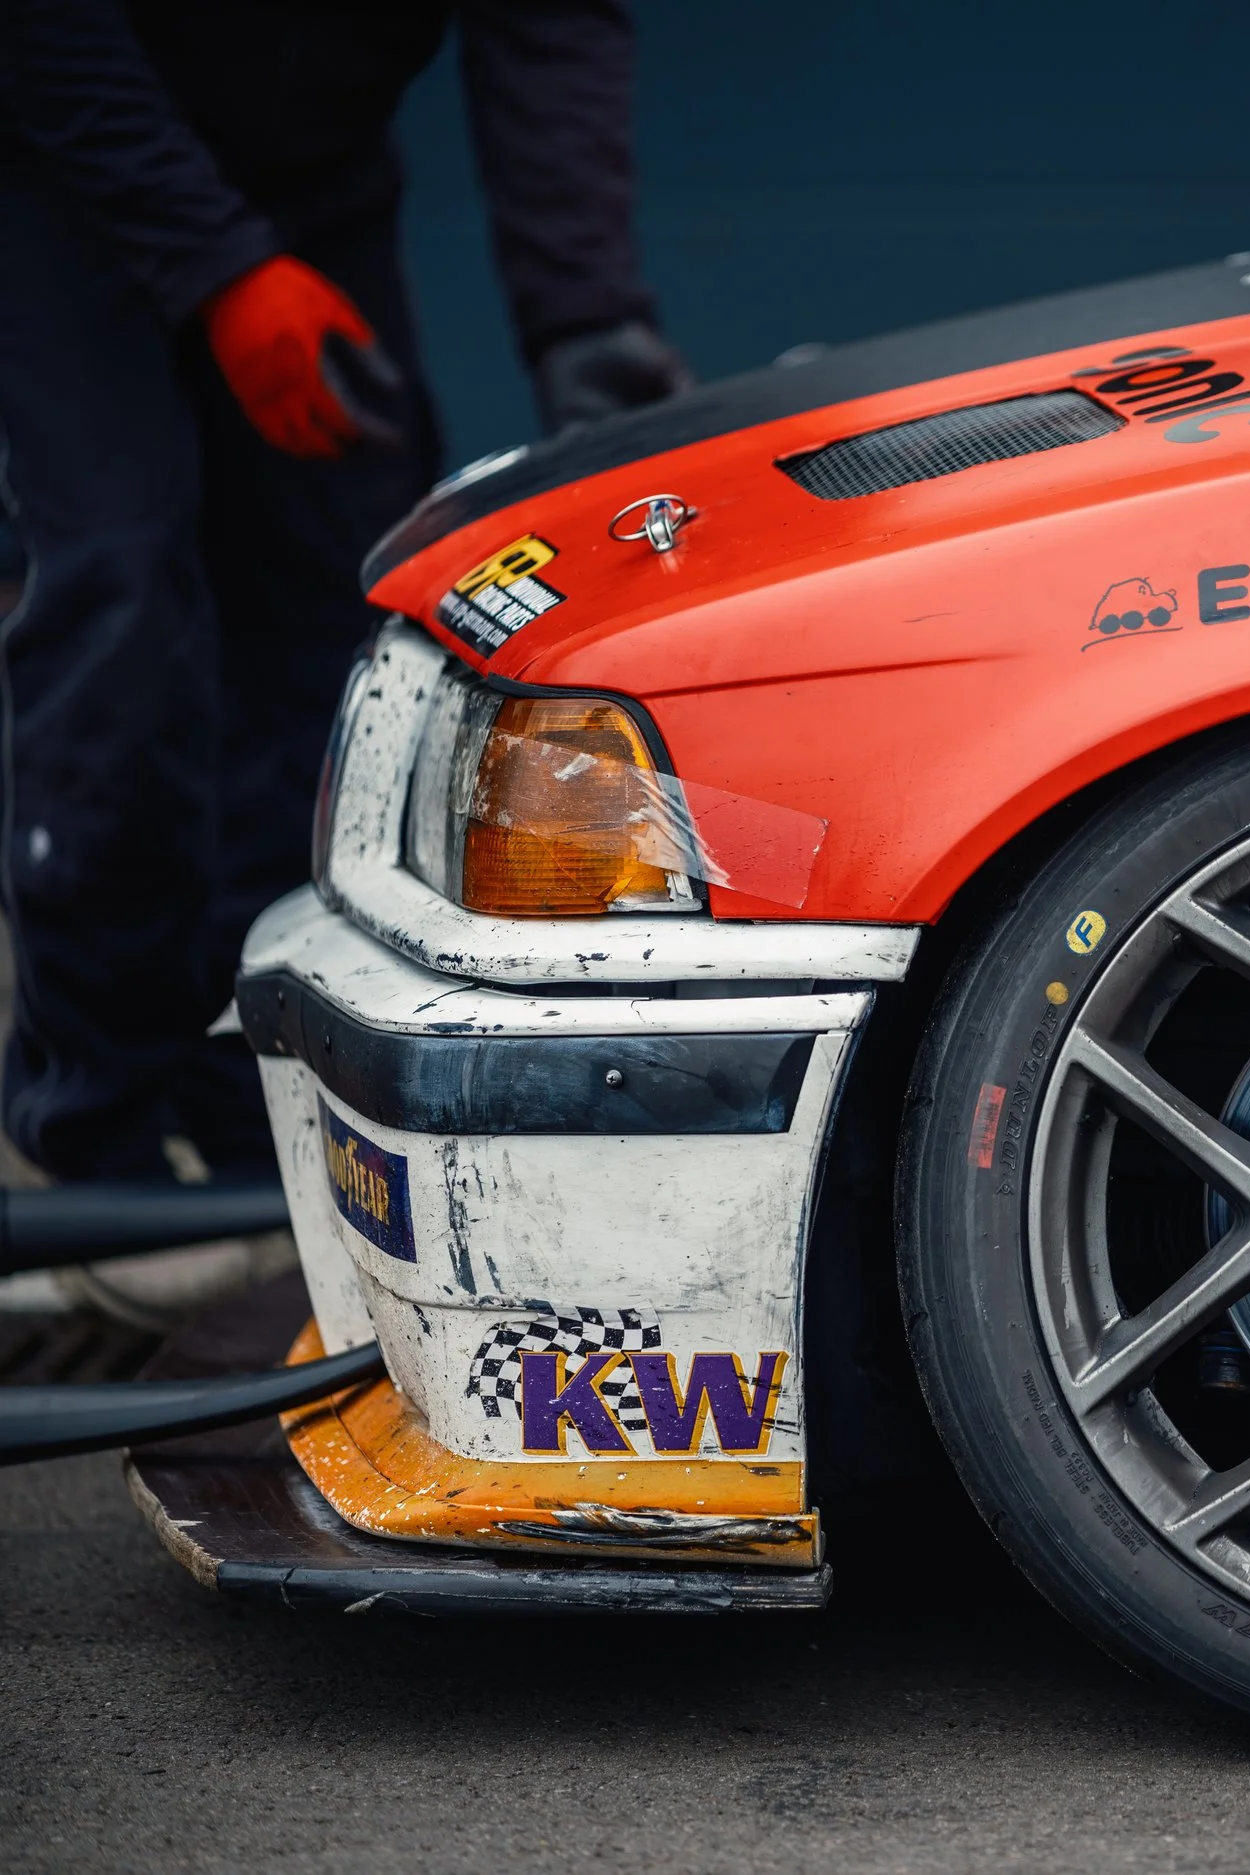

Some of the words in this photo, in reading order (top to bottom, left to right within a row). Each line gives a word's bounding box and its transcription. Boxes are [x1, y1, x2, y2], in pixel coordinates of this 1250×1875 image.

[495, 601, 535, 631] PARTS
[1074, 916, 1094, 948] F
[1000, 1003, 1062, 1169] DUNLOP
[520, 1349, 789, 1457] KW
